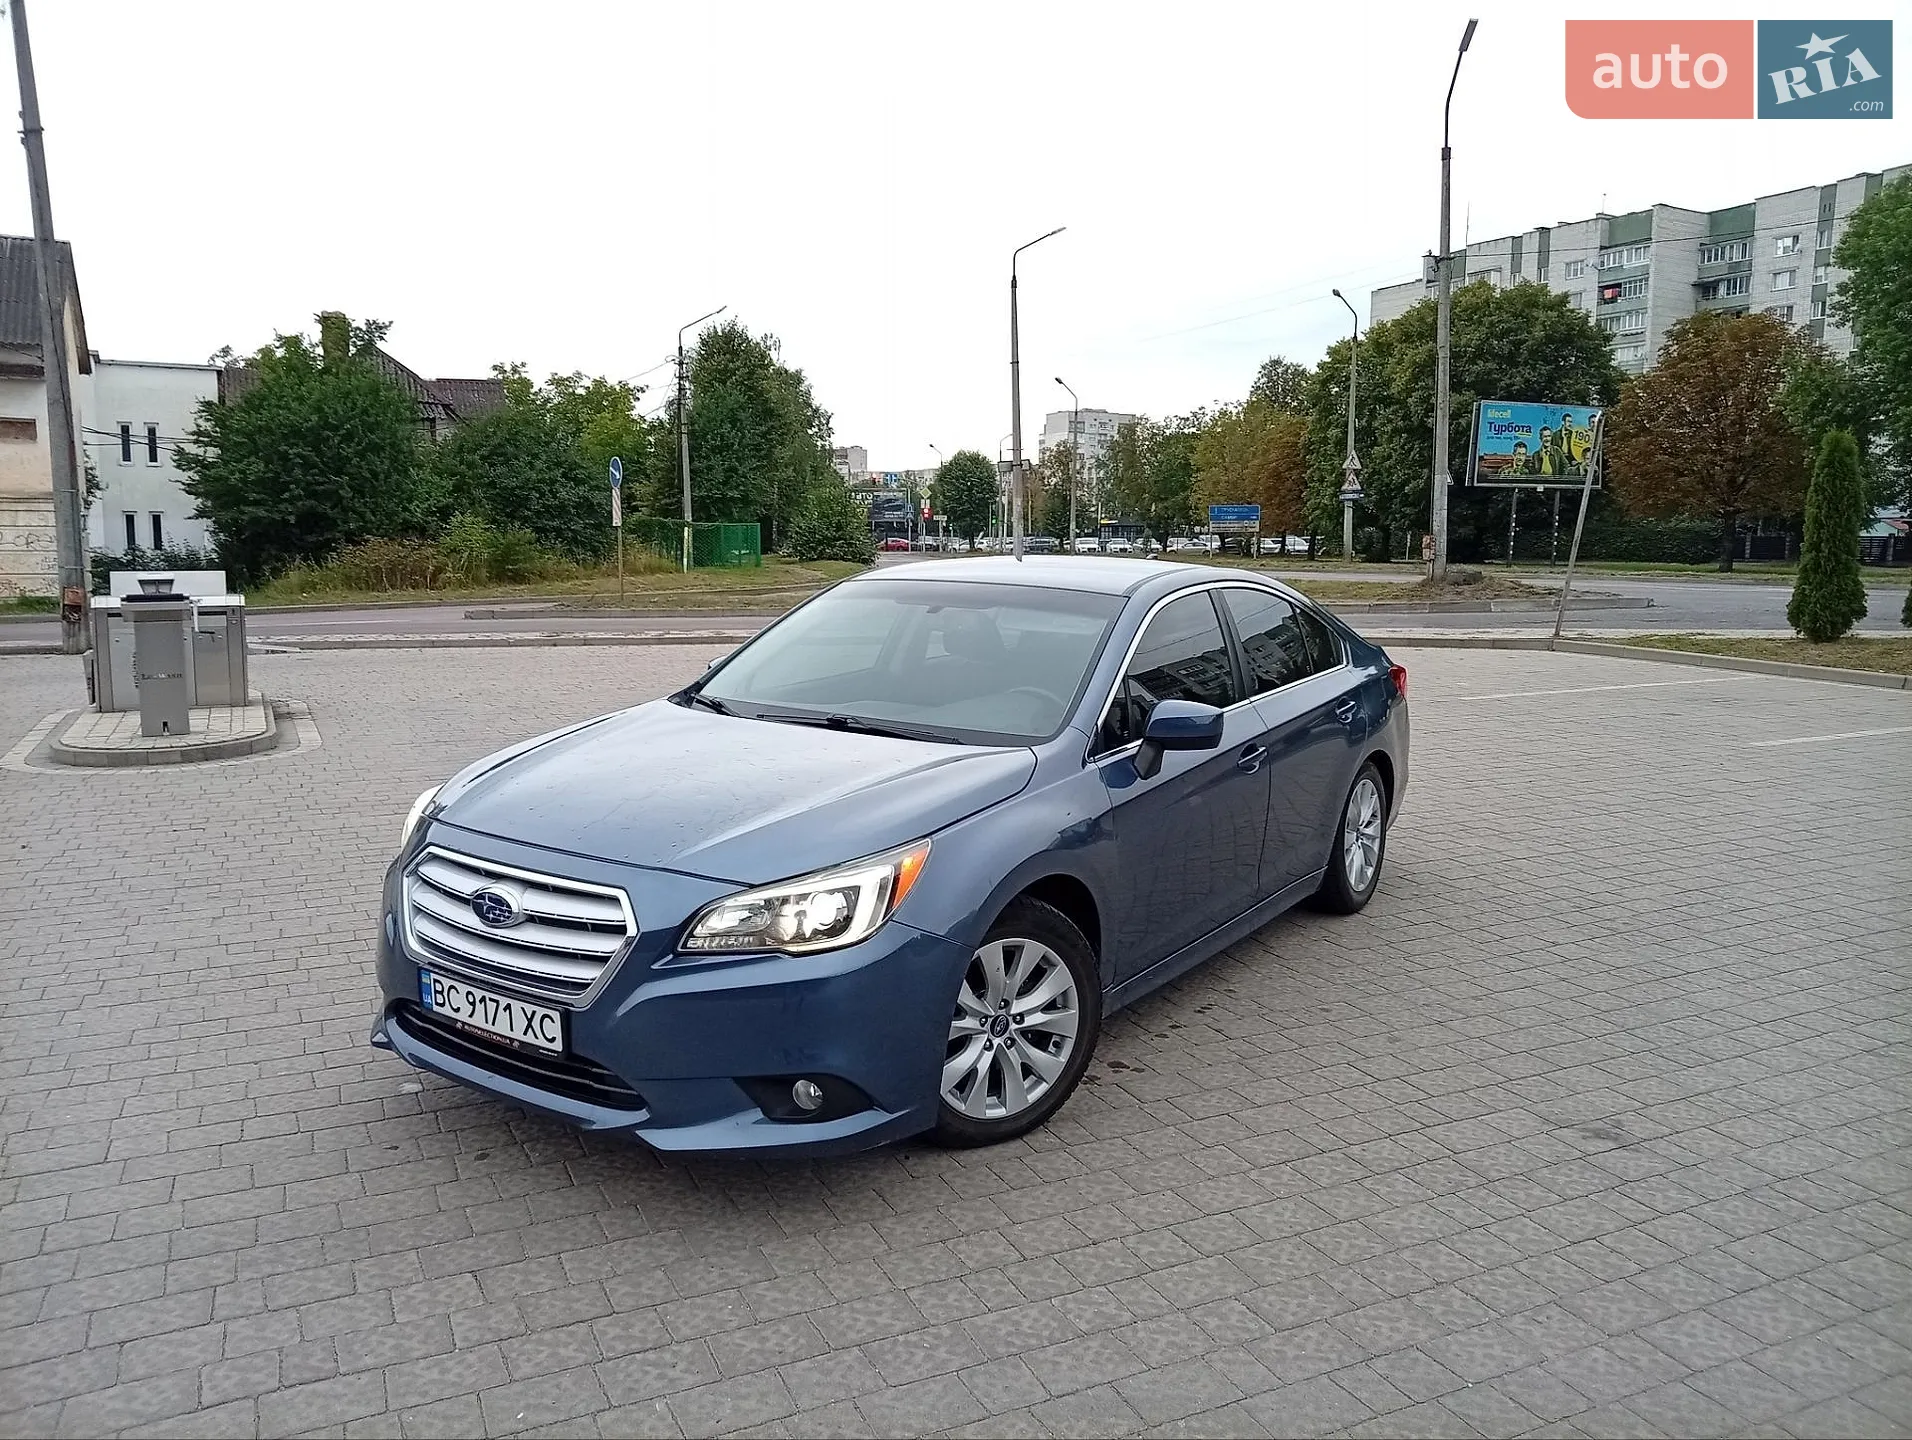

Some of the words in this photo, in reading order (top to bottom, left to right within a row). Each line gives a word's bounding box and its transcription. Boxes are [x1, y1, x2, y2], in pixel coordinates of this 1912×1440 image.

[1487, 421, 1532, 436] Турбота
[433, 979, 461, 1014] BC
[465, 990, 514, 1032] 9171
[521, 1006, 557, 1044] XC
